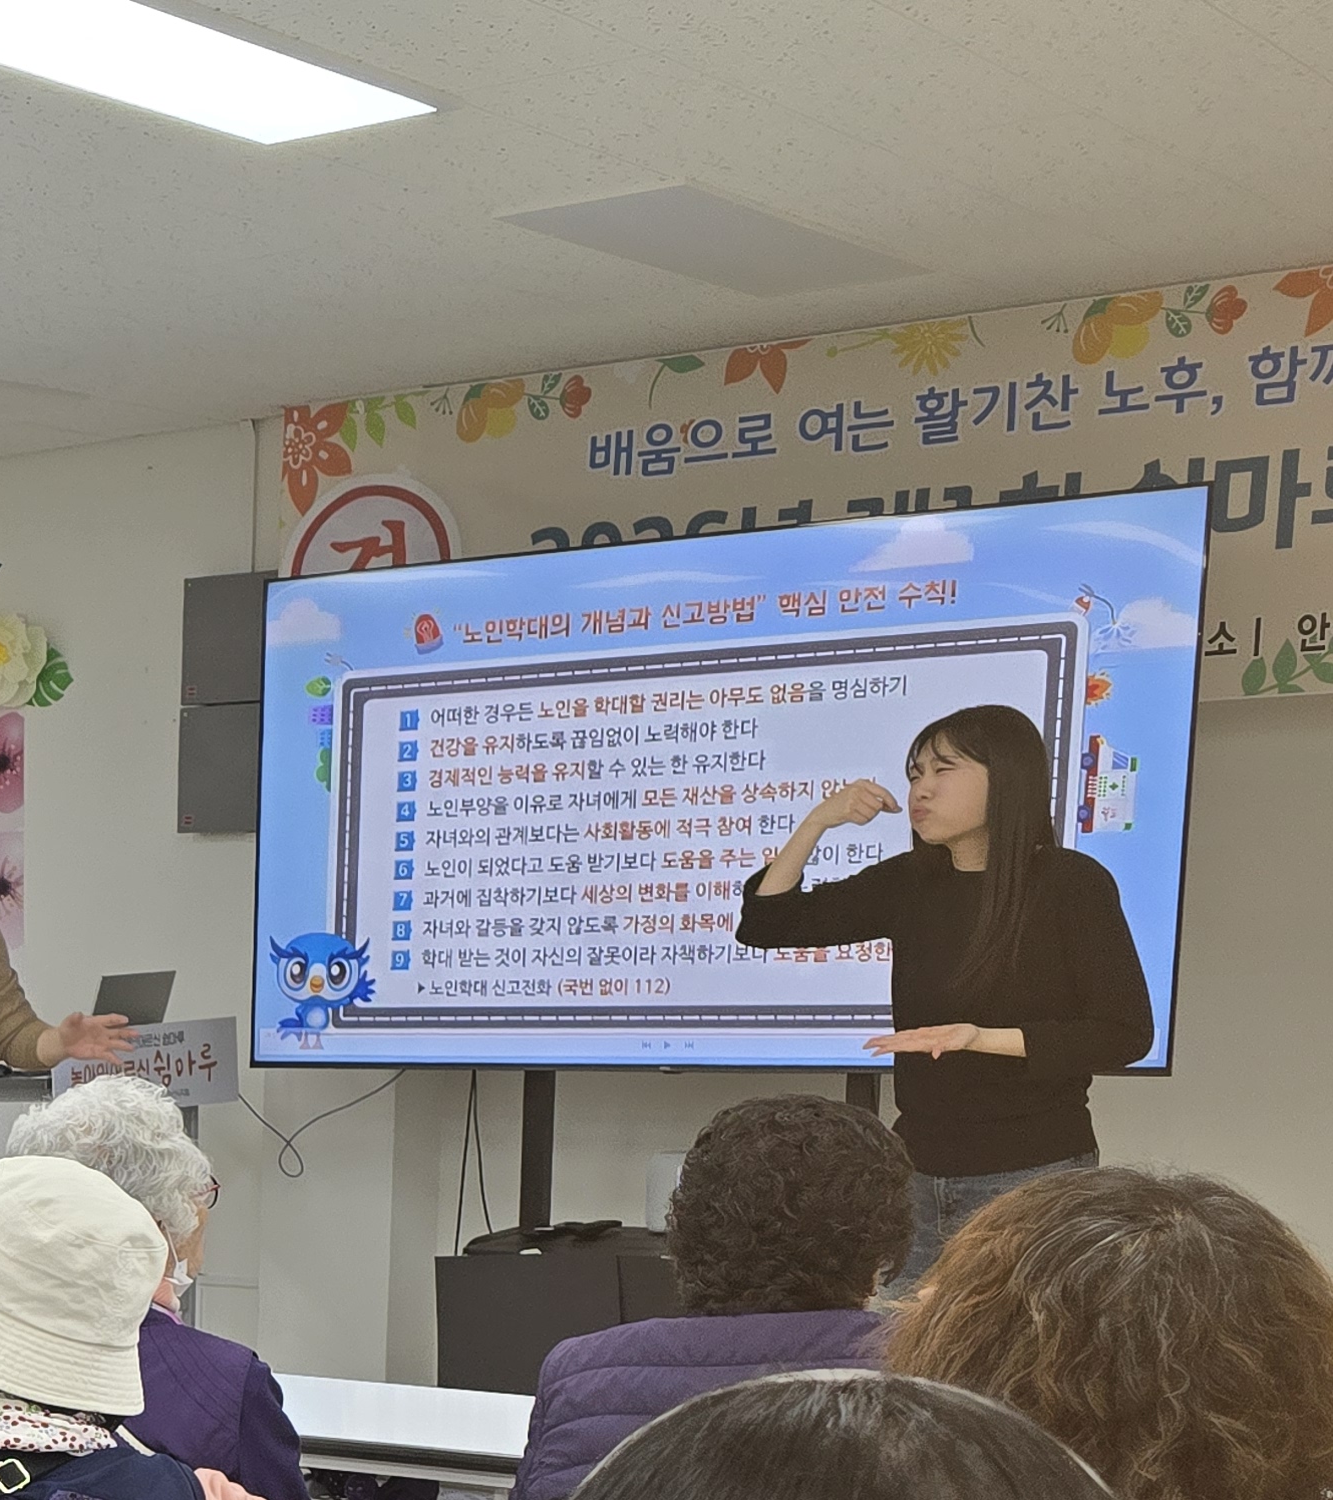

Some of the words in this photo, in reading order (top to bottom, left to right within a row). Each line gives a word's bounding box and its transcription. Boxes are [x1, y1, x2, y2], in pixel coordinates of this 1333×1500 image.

[588, 412, 777, 477] 배움으로
[798, 400, 895, 453] 여는
[914, 372, 1079, 445] 활기찬
[1097, 356, 1224, 417] 노후,
[581, 605, 652, 635] 개념과
[778, 590, 827, 618] 핵심
[839, 584, 886, 613] 안전
[898, 579, 958, 609] 수칙!
[430, 705, 480, 727] 어떠한
[484, 702, 534, 724] 경우든
[537, 697, 590, 720] 노인을
[595, 693, 646, 715] 학대할
[651, 690, 705, 712] 권리는
[710, 685, 764, 708] 아무도
[770, 680, 827, 705] 없음을
[832, 675, 908, 700] 명심하기
[430, 736, 479, 758] 건강을
[483, 731, 567, 756] 유지하도록
[571, 725, 639, 750] 끊임없이
[644, 721, 717, 745] 노력해야
[722, 718, 759, 740] 한다
[429, 766, 493, 789] 경제적인
[498, 763, 548, 784] 능력을
[552, 759, 604, 782] 유지할
[608, 758, 626, 778] 수
[631, 756, 666, 778] 있는
[670, 753, 688, 775] 한
[692, 750, 766, 773] 유지한다
[427, 796, 509, 818] 노인부양을
[513, 794, 564, 815] 이유로
[568, 789, 637, 811] 자녀에게
[642, 786, 678, 808] 모든
[683, 784, 736, 806] 재산을
[741, 779, 814, 804] 상속하지
[425, 827, 491, 849] 자녀와의
[495, 824, 580, 846] 관계보다는
[583, 819, 670, 842] 사회활동에
[676, 817, 713, 838] 적극
[717, 814, 752, 837] 참여
[758, 813, 796, 835] 한다
[424, 859, 473, 879] 노인이
[477, 856, 543, 877] 되었다고
[547, 854, 582, 875] 도움
[587, 851, 656, 873] 받기보다
[661, 848, 715, 870] 도움을
[719, 848, 756, 868] 주는
[846, 843, 883, 864] 한다
[423, 888, 472, 909] 과거에
[476, 885, 577, 908] 집착하기보다
[581, 883, 633, 904] 세상의
[638, 882, 690, 903] 변화를
[422, 919, 471, 939] 자녀와
[475, 918, 525, 938] 갈등을
[529, 917, 562, 936] 갖지
[567, 915, 619, 935] 않도록
[623, 913, 675, 934] 가정의
[680, 912, 733, 933] 화목에
[422, 949, 453, 969] 학대
[458, 948, 491, 968] 받는
[494, 947, 526, 967] 것이
[531, 946, 582, 967] 자신의
[586, 945, 656, 966] 잘못이라
[429, 979, 488, 997] 노인학대
[492, 979, 552, 997] 신고전화
[557, 978, 593, 997] (국번
[599, 978, 629, 996] 없이
[634, 978, 671, 996] 112)
[154, 1043, 218, 1087] 쉼마루
